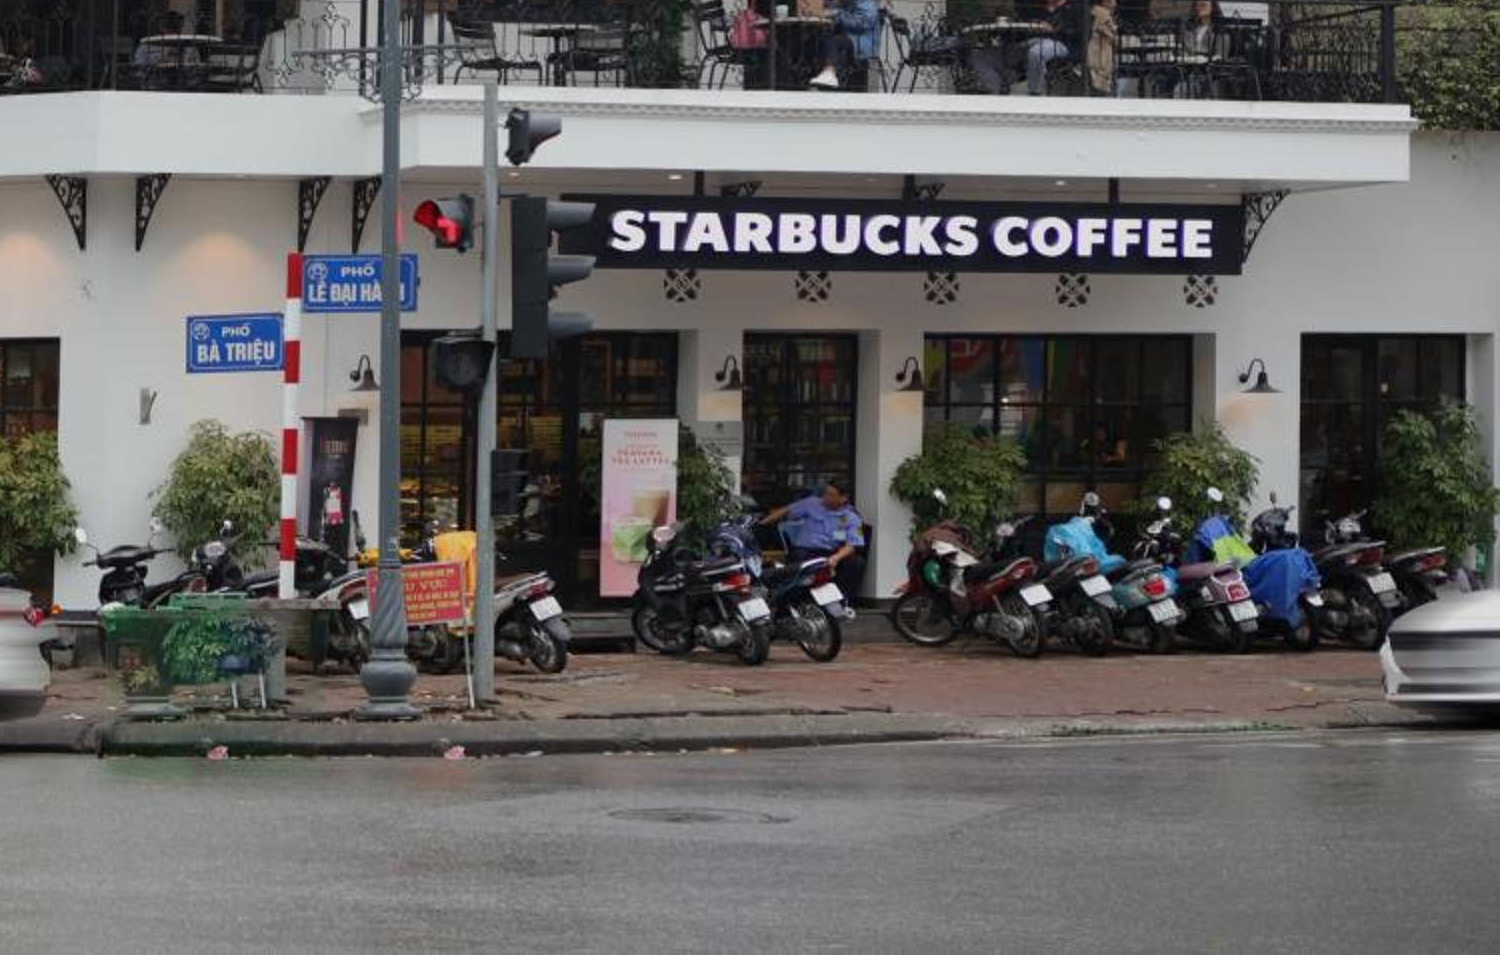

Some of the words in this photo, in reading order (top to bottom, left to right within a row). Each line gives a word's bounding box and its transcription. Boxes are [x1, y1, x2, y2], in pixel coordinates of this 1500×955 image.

[610, 210, 979, 257] STARBUCKS
[993, 216, 1213, 258] COFFEE
[197, 337, 220, 363] BÀ
[226, 339, 275, 366] TRIỆU
